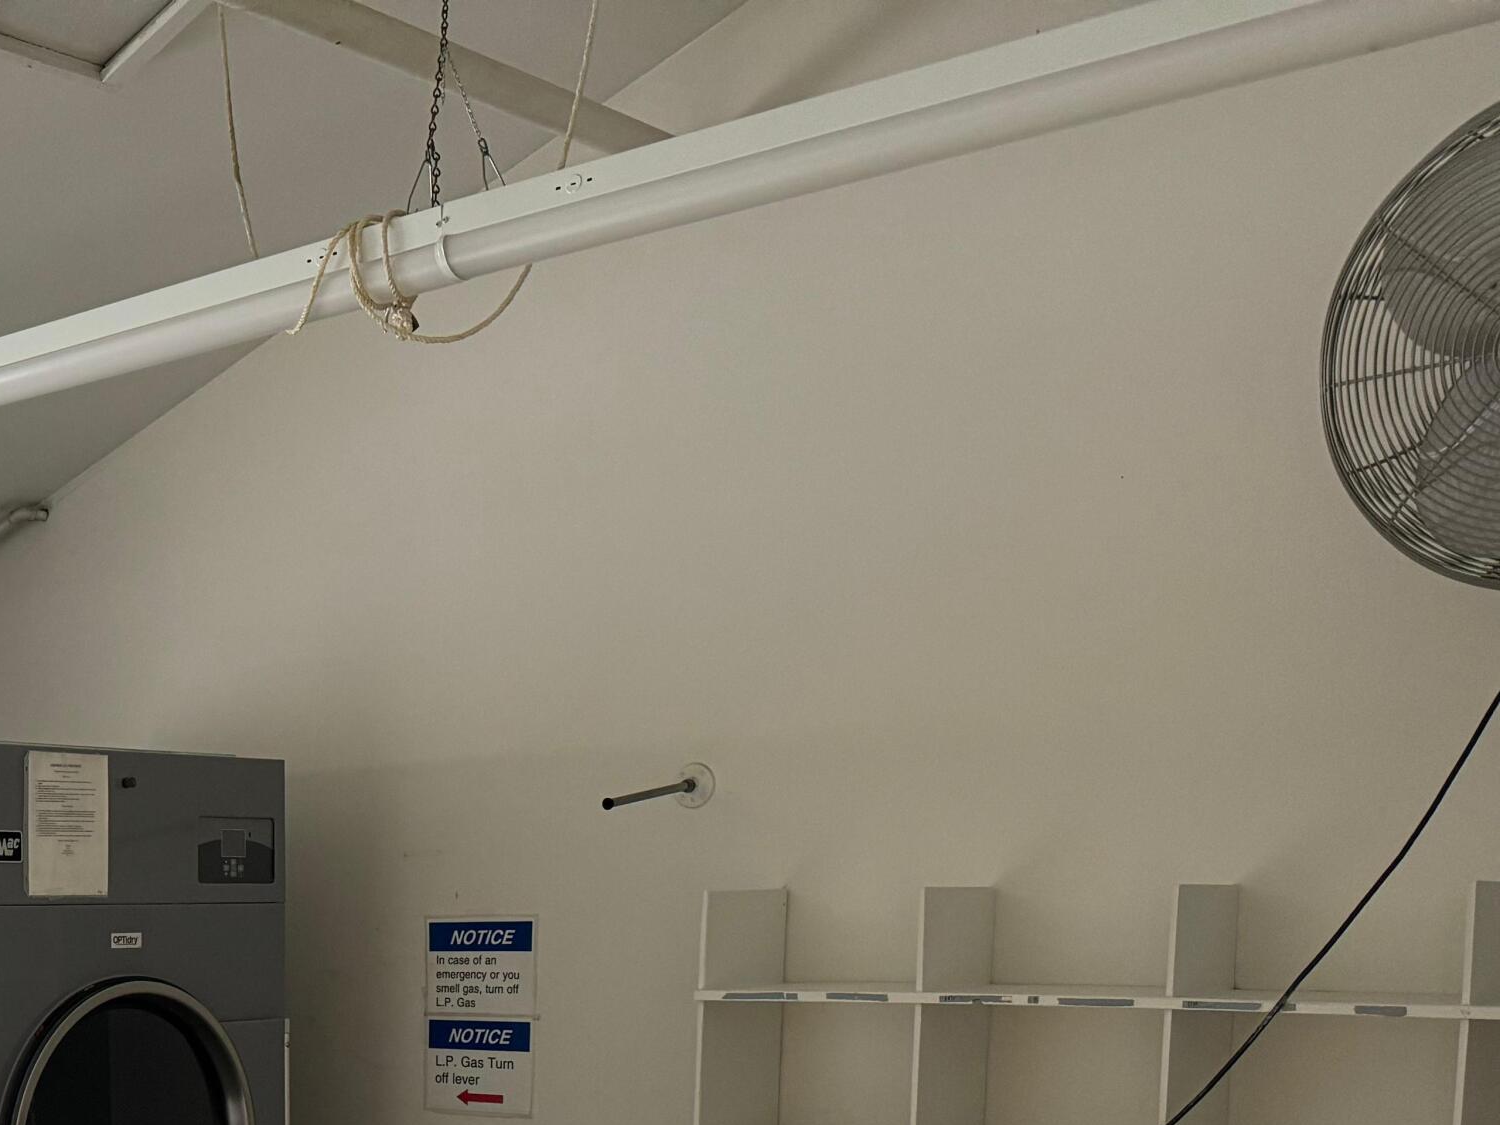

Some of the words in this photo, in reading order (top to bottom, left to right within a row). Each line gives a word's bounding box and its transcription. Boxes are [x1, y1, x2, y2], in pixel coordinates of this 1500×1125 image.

[450, 929, 515, 945] NOTICE
[436, 955, 445, 965] In
[447, 956, 470, 965] case
[472, 955, 482, 965] of
[485, 956, 497, 965] an
[436, 970, 487, 982] emergency
[489, 971, 500, 980] or
[502, 971, 520, 982] you
[436, 984, 459, 993] smell
[462, 986, 482, 996] gas,
[485, 984, 503, 994] turn
[506, 984, 519, 994] off
[436, 997, 454, 1008] L.P.
[456, 998, 476, 1008] Gas
[448, 1028, 513, 1045] NOTICE
[435, 1055, 457, 1067] L.P.
[461, 1056, 484, 1069] Gas
[487, 1057, 514, 1070] Turn
[435, 1073, 449, 1084] off
[452, 1073, 480, 1085] lever
